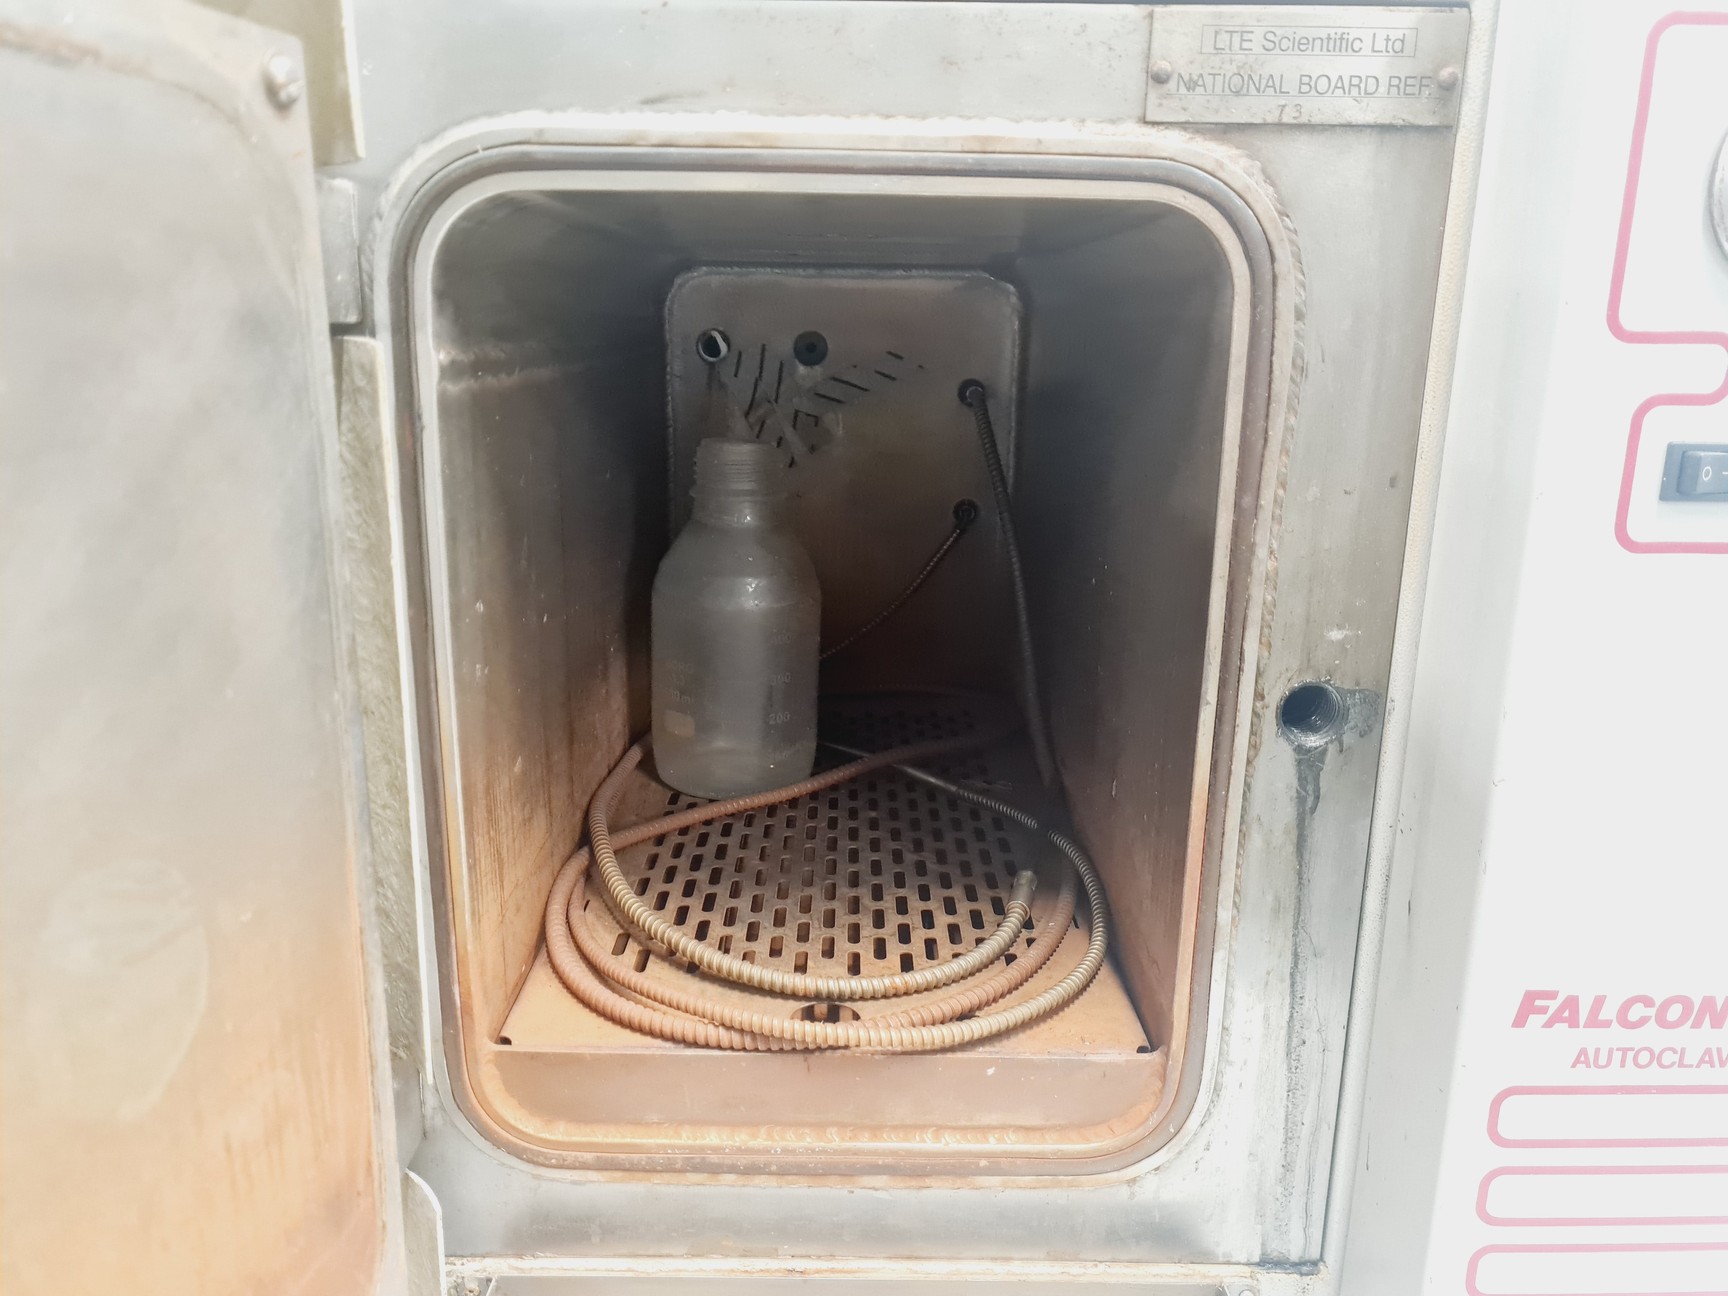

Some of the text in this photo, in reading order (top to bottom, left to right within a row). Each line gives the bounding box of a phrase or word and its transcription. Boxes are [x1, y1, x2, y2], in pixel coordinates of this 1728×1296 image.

[1212, 30, 1406, 54] LTE Scientific Ltd
[1176, 72, 1290, 95] NATIONAL
[1299, 74, 1380, 96] BOARD
[768, 711, 791, 725] 200
[1510, 989, 1728, 1030] FALCON
